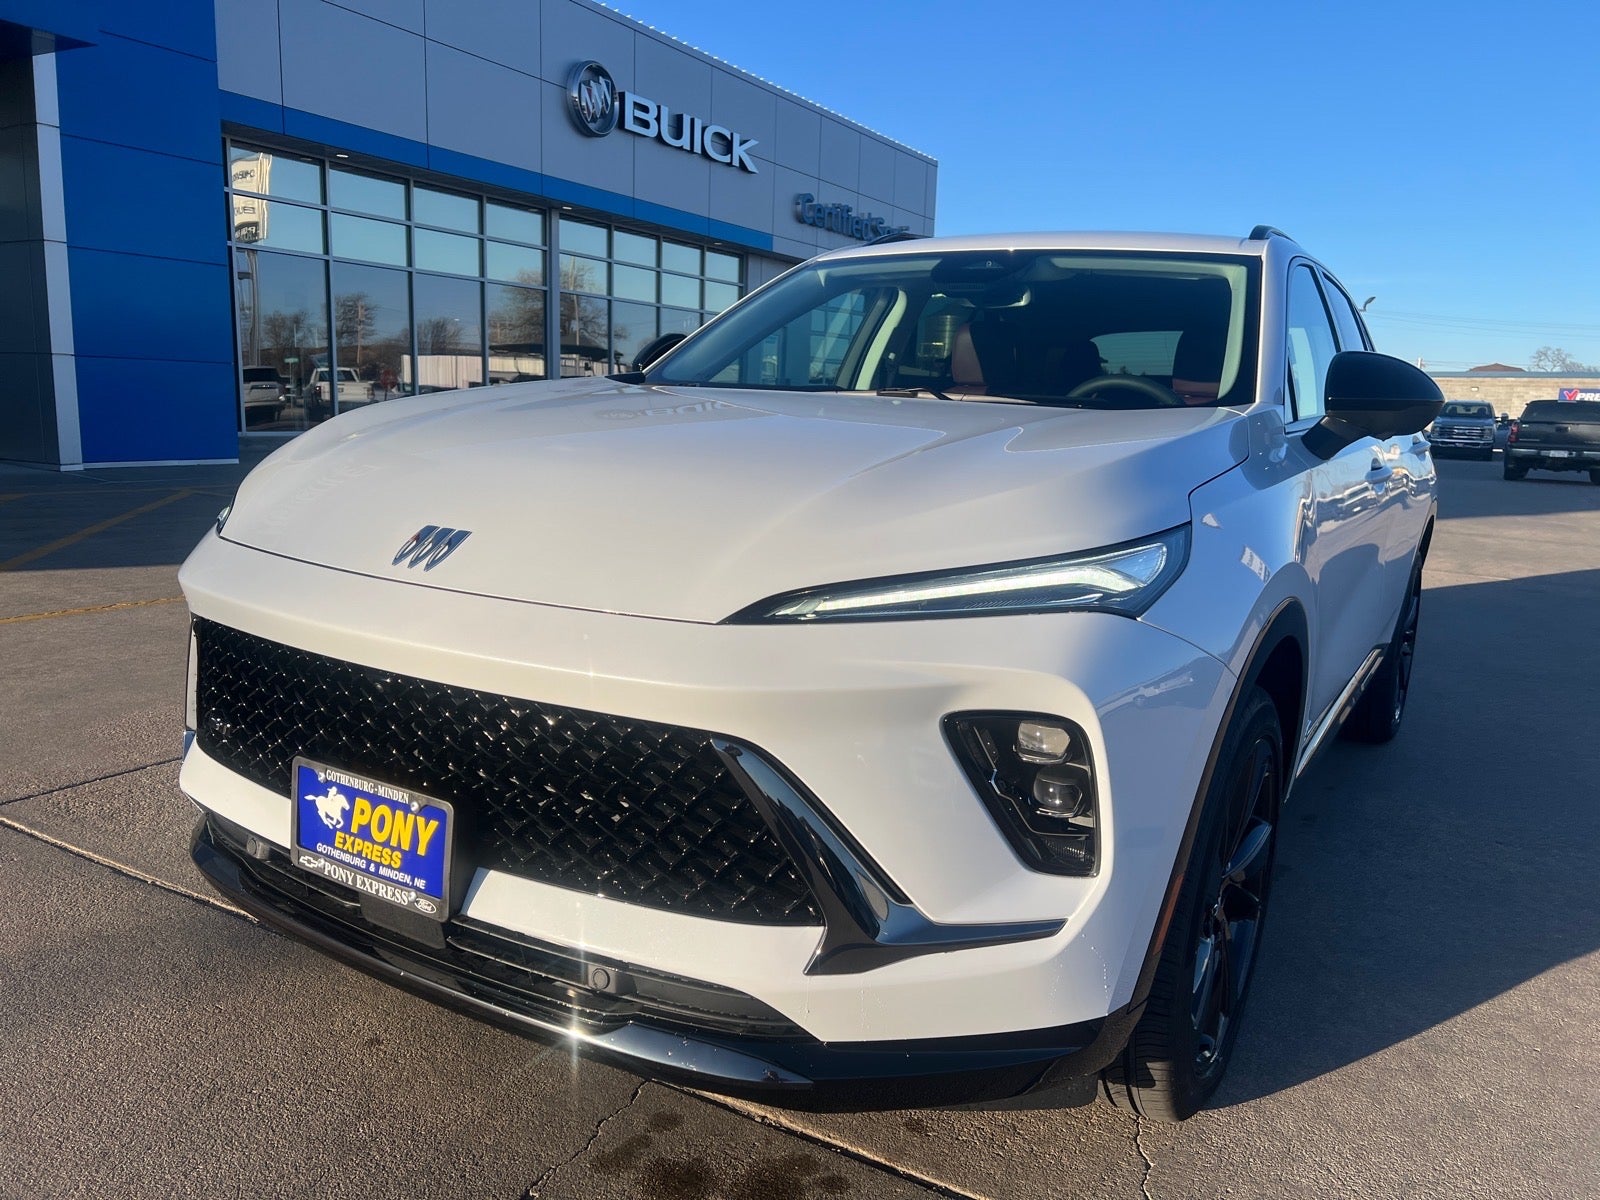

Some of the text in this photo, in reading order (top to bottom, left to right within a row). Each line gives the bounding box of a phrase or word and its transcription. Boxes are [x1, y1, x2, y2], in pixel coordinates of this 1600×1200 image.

[622, 91, 759, 174] BUICK
[794, 193, 873, 241] Certified
[334, 831, 403, 869] EXPRESS
[350, 797, 439, 857] PONY
[316, 842, 427, 890] GOTHENBURG & MINDEN, NE
[323, 861, 409, 906] PONY EXPRESS
